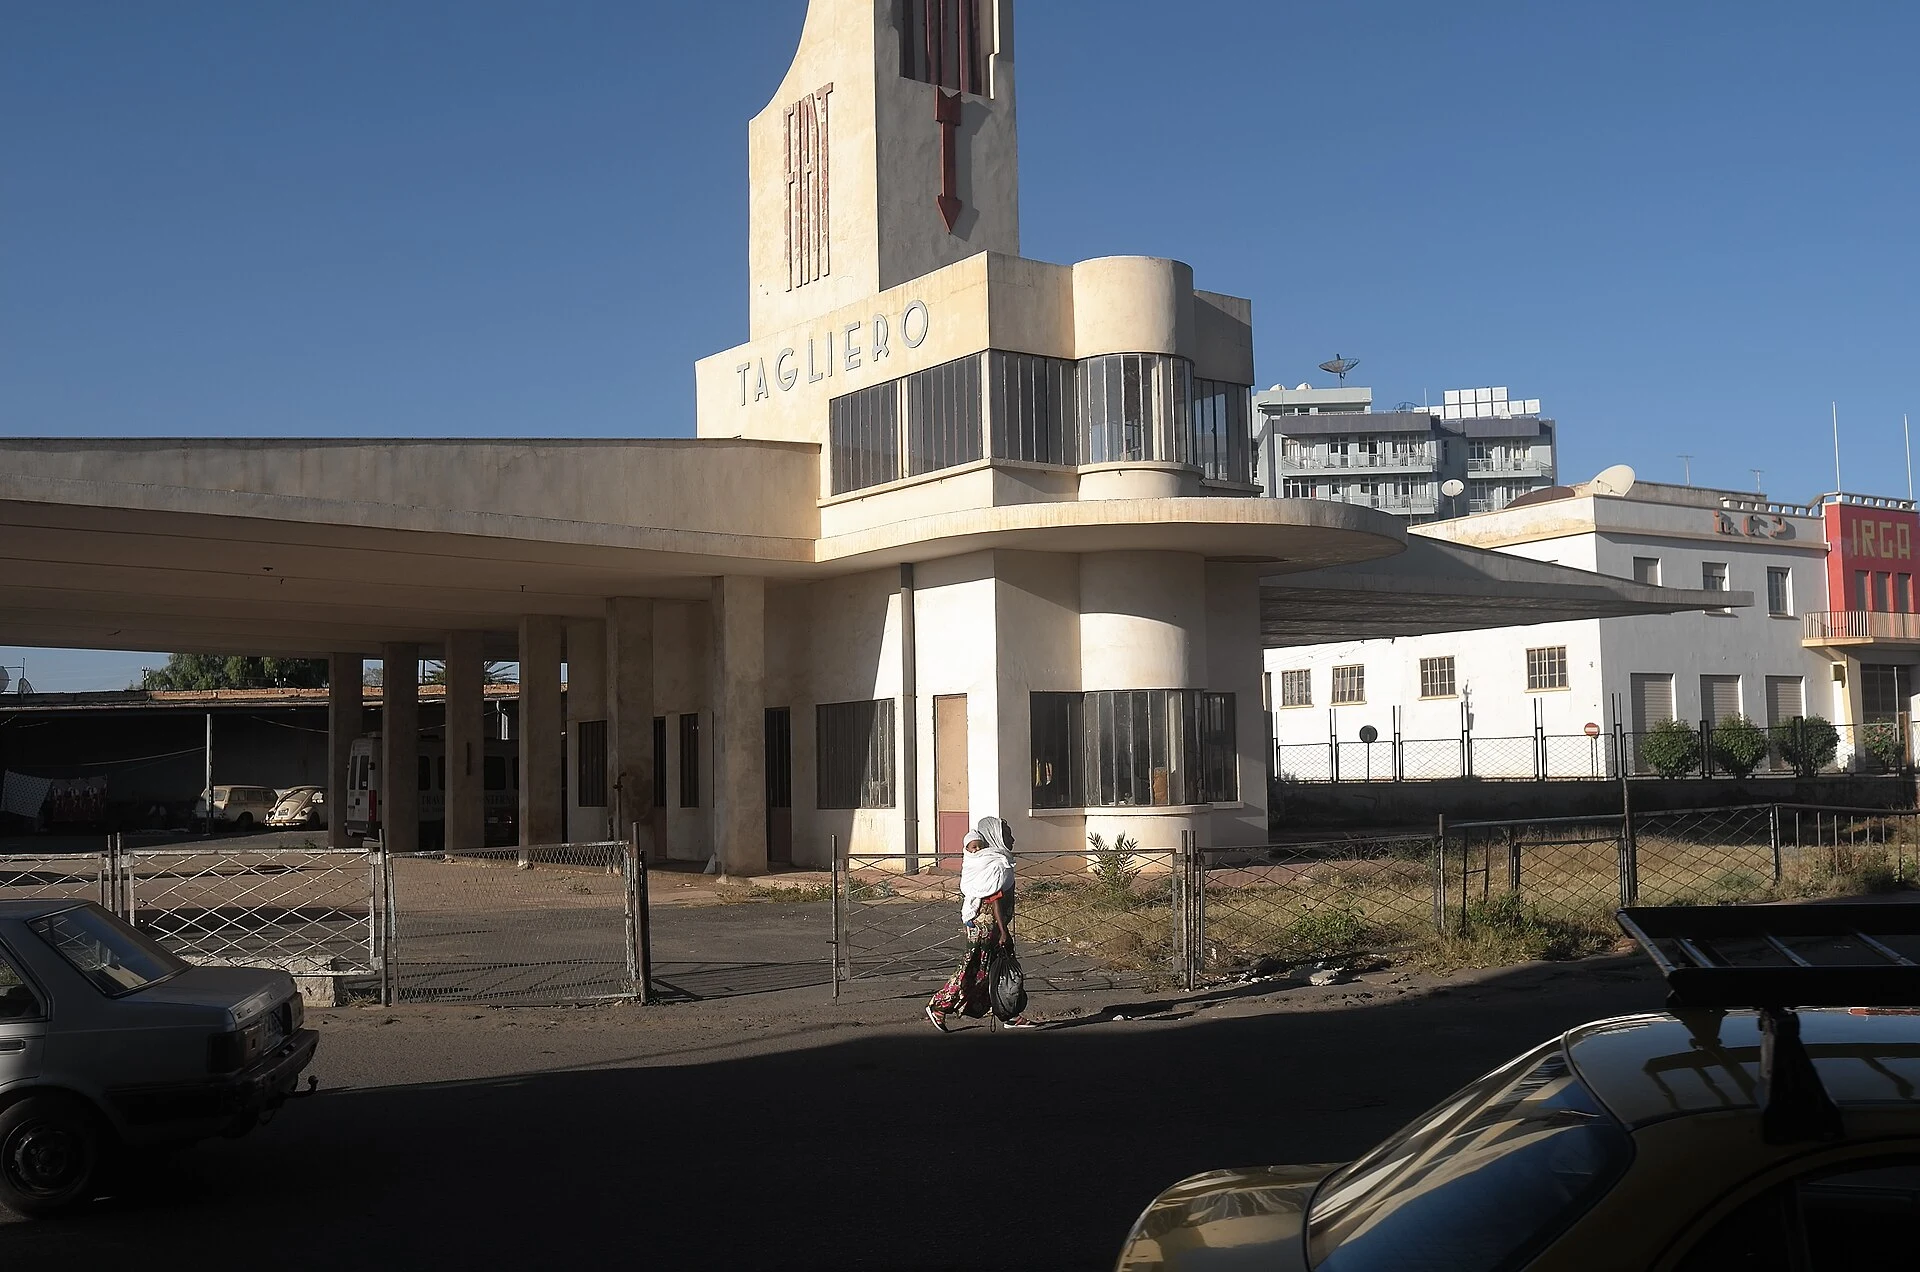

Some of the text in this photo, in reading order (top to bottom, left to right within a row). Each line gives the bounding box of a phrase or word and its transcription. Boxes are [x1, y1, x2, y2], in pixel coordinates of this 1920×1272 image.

[783, 81, 834, 292] FIAT
[736, 299, 929, 406] TAGLIERO
[1852, 518, 1911, 560] IRGA
